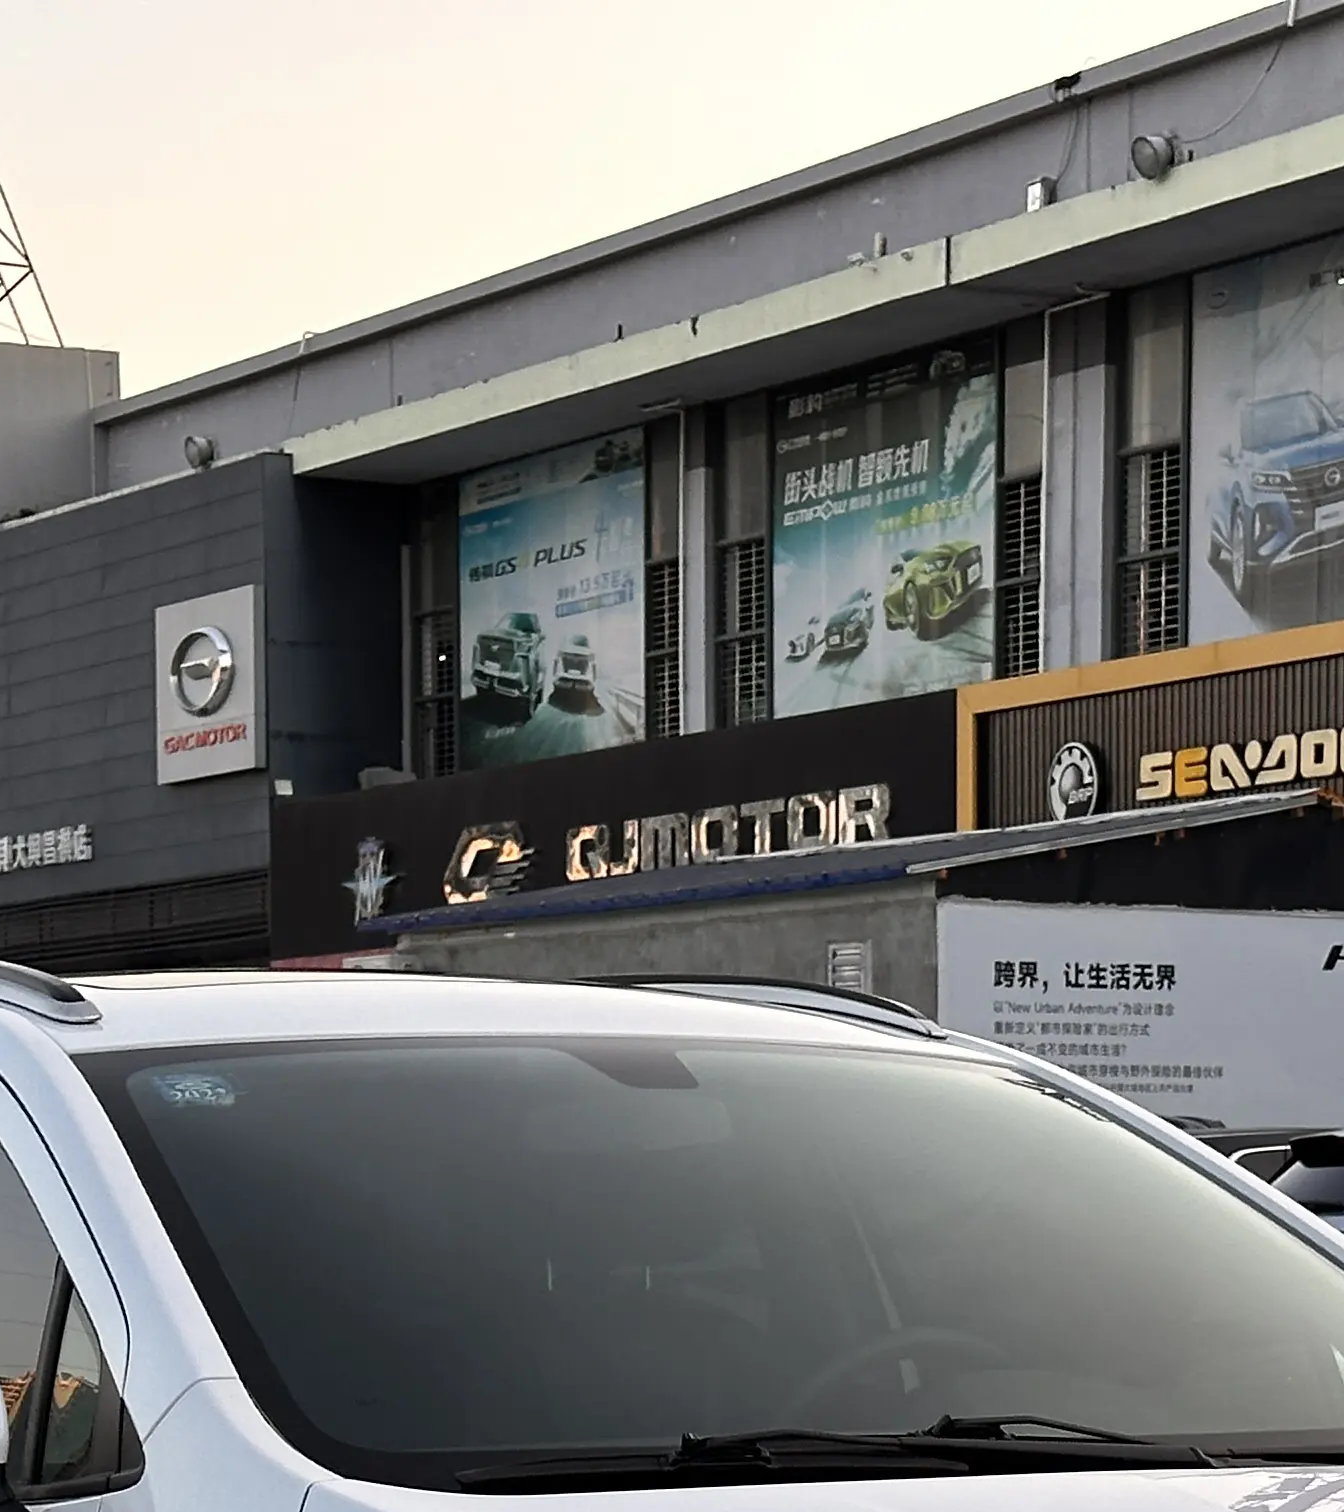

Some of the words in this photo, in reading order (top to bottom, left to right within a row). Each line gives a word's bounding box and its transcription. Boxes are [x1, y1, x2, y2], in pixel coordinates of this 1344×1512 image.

[784, 458, 854, 506] 街头战机
[533, 538, 588, 568] PLUS
[993, 961, 1177, 993] 跨界，让生活无界
